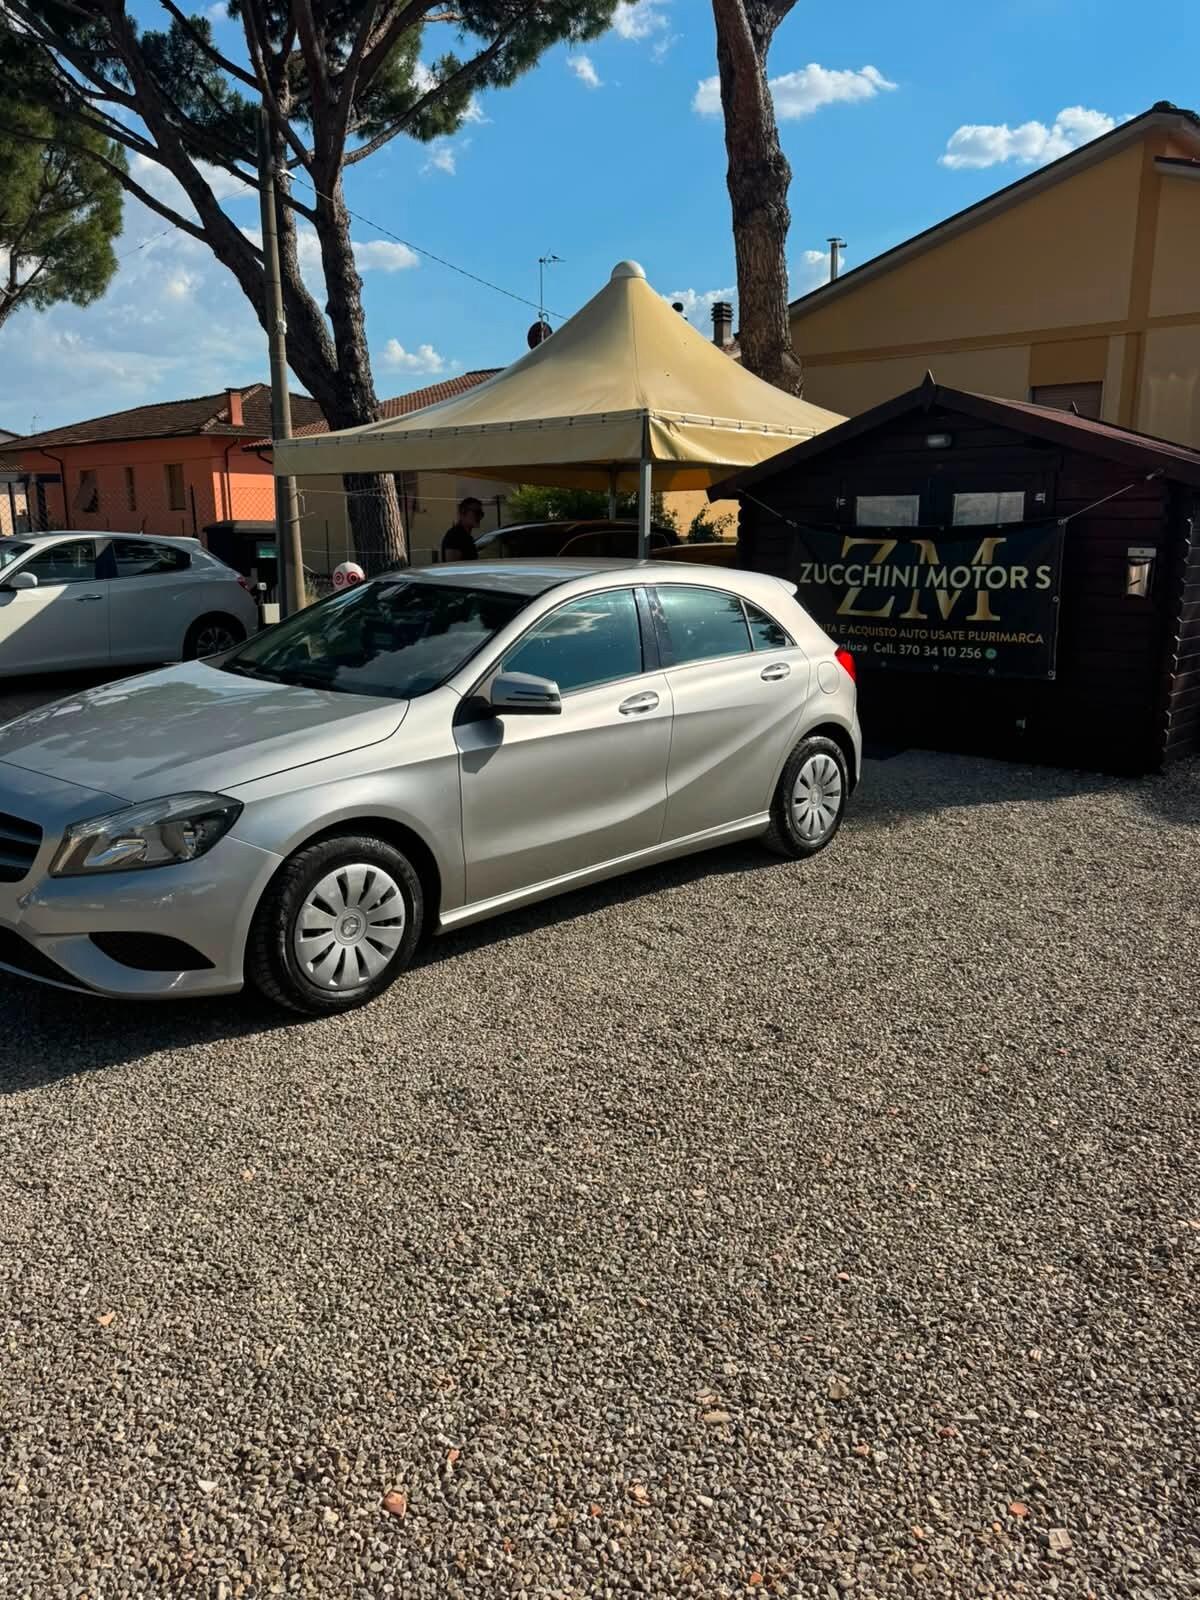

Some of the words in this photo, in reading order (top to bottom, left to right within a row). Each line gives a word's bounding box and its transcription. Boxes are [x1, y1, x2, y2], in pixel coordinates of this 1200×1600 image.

[799, 562, 918, 588] ZUCCHINI
[840, 625, 846, 634] E
[848, 625, 897, 638] ACQUISTO
[898, 629, 928, 640] AUTO
[930, 630, 965, 641] USATE
[968, 631, 1044, 644] PLURIMARCA
[899, 644, 920, 656] 370
[924, 645, 938, 656] 34
[942, 646, 956, 657] 10
[959, 647, 982, 659] 256
